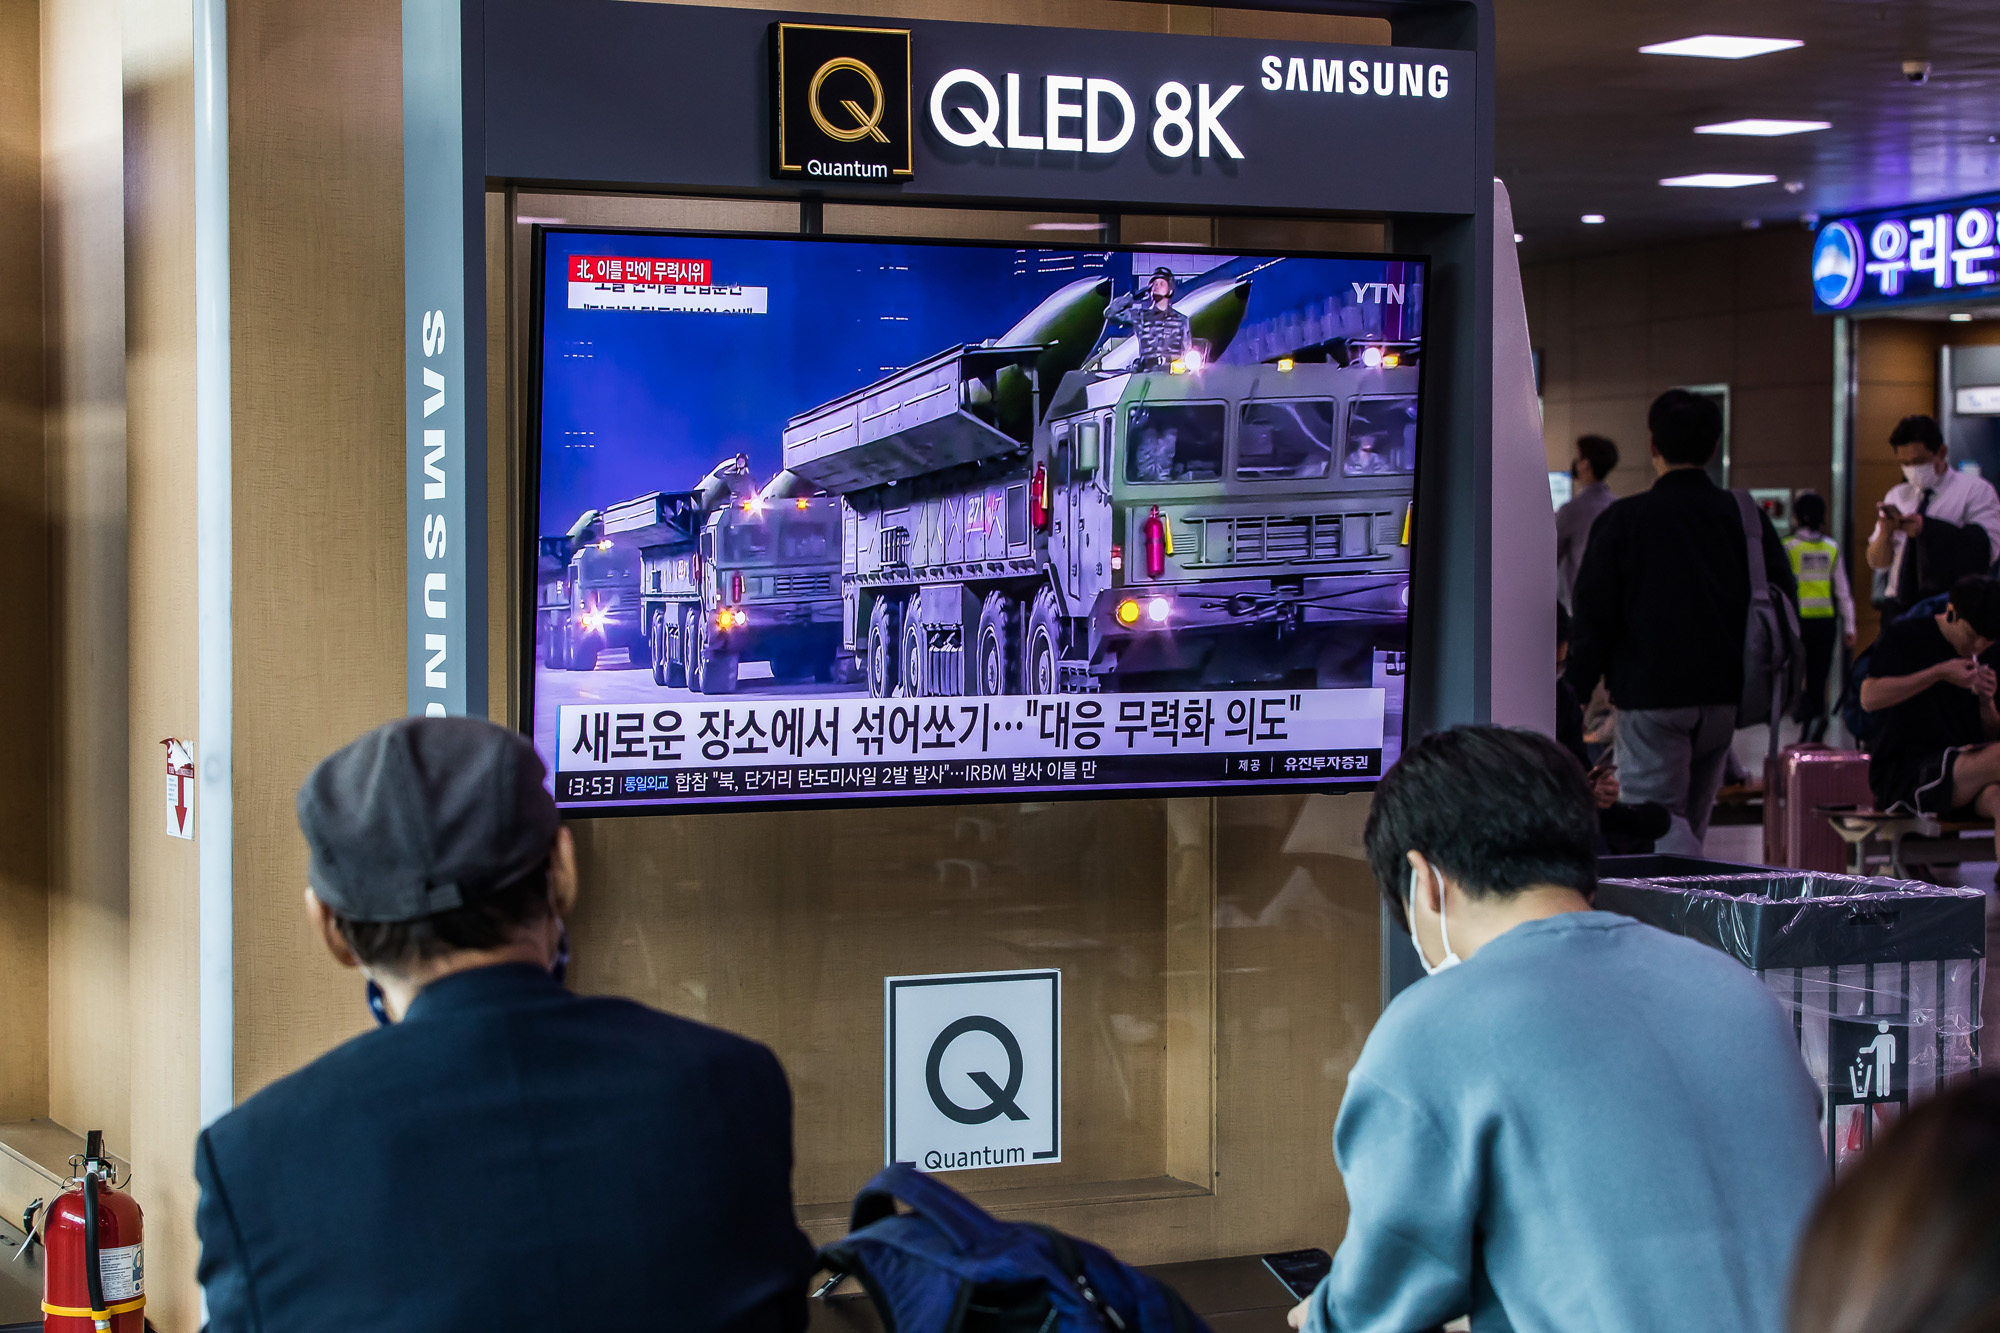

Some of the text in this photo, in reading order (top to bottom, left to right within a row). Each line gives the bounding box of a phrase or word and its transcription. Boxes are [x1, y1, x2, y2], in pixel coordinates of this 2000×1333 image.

[1260, 55, 1449, 99] SAMSUNG
[808, 56, 891, 144] Q
[929, 68, 1245, 160] QLED 8K
[806, 158, 889, 180] Quantum
[596, 259, 623, 281] 이틀
[625, 260, 652, 281] 만에
[653, 262, 704, 283] 무력시위
[1865, 207, 2000, 296] 우리은
[1351, 282, 1406, 305] YTN
[571, 710, 686, 764] 새로운
[696, 706, 841, 761] 장소에서
[1114, 698, 1216, 749] 무력화
[1224, 694, 1302, 746] 의도"
[568, 776, 615, 797] 13:53
[624, 774, 669, 793] 통일외교
[674, 771, 709, 793] 합참
[712, 770, 739, 793] "북,
[744, 769, 793, 791] 단거리
[798, 766, 878, 788] 탄도미사일
[881, 765, 909, 786] 2발
[1011, 761, 1043, 782] 발사
[1046, 761, 1078, 781] 이틀
[1081, 760, 1098, 780] 만
[1238, 755, 1370, 773] 제공 유진투자증권
[924, 1014, 1031, 1126] Q
[923, 1145, 1026, 1171] Quantum
